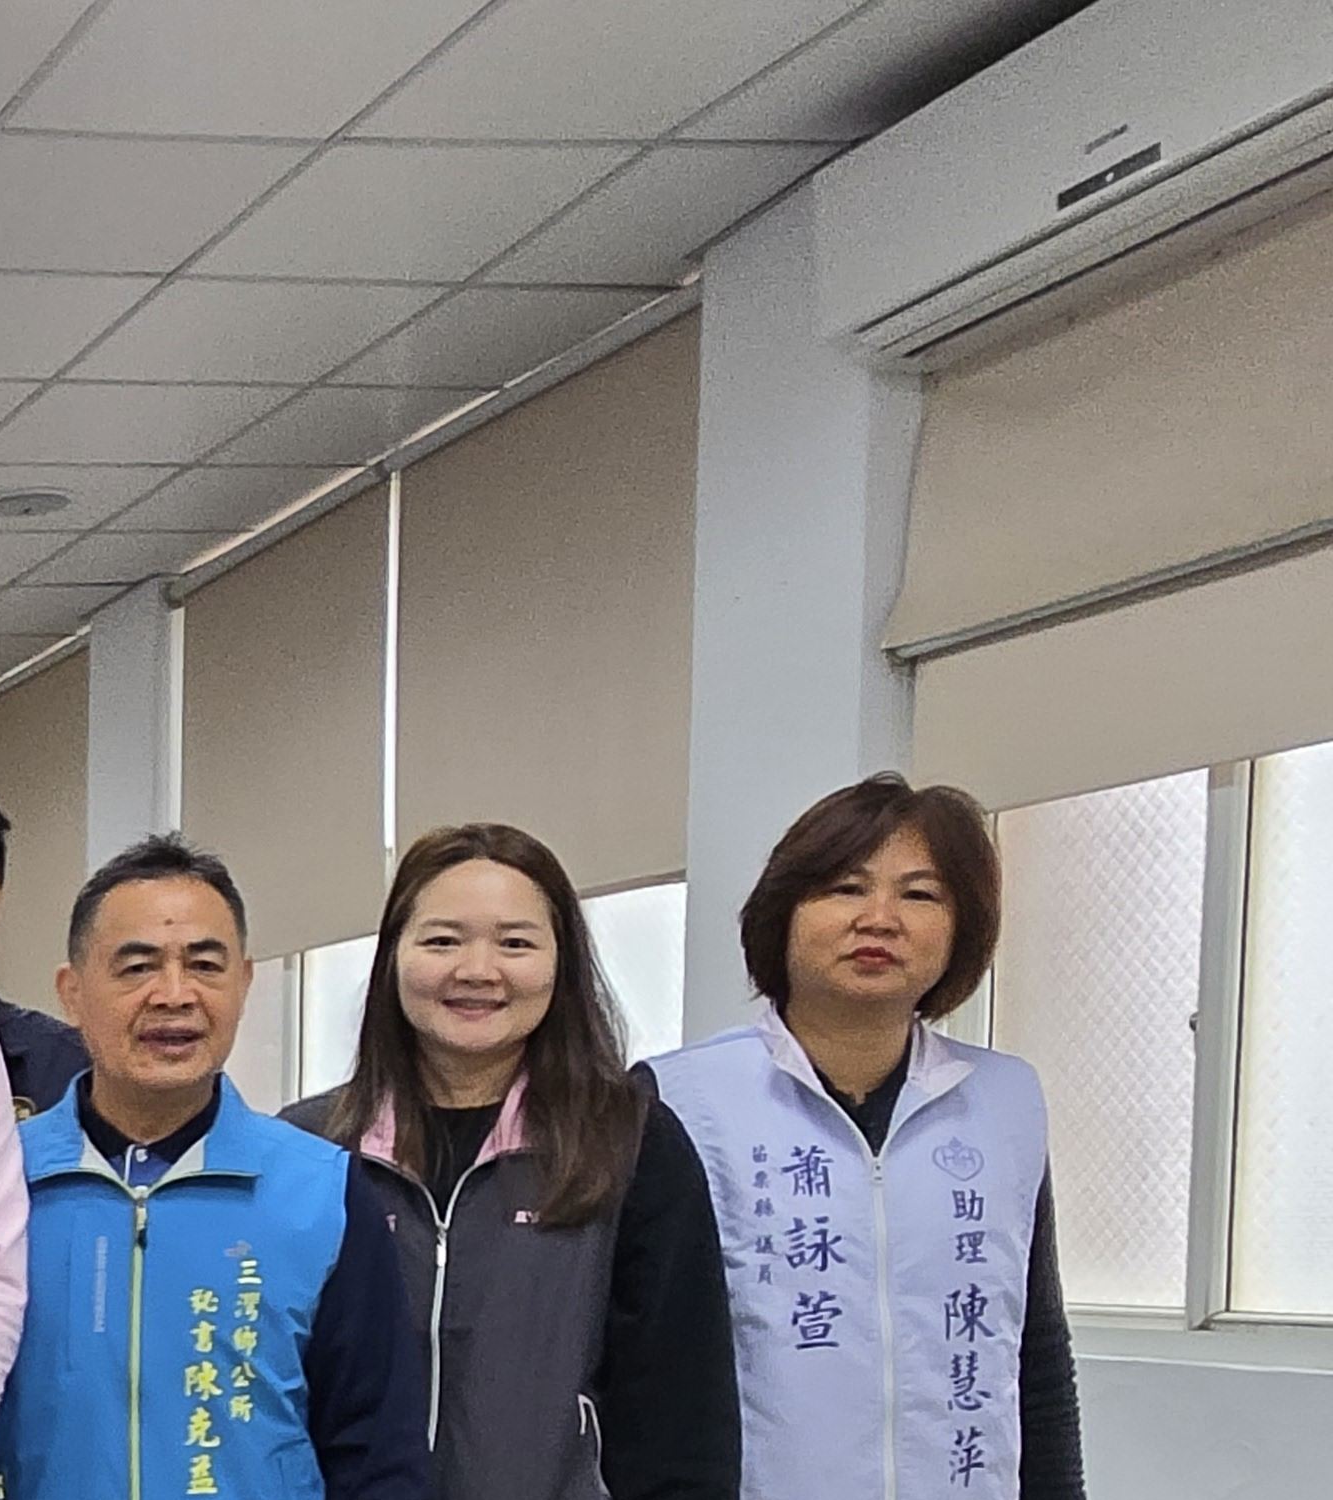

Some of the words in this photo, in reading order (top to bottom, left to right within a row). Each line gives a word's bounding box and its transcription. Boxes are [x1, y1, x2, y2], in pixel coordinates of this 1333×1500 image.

[781, 1144, 847, 1350] 蕭詠萱
[229, 1259, 263, 1423] 三灣鄉公所
